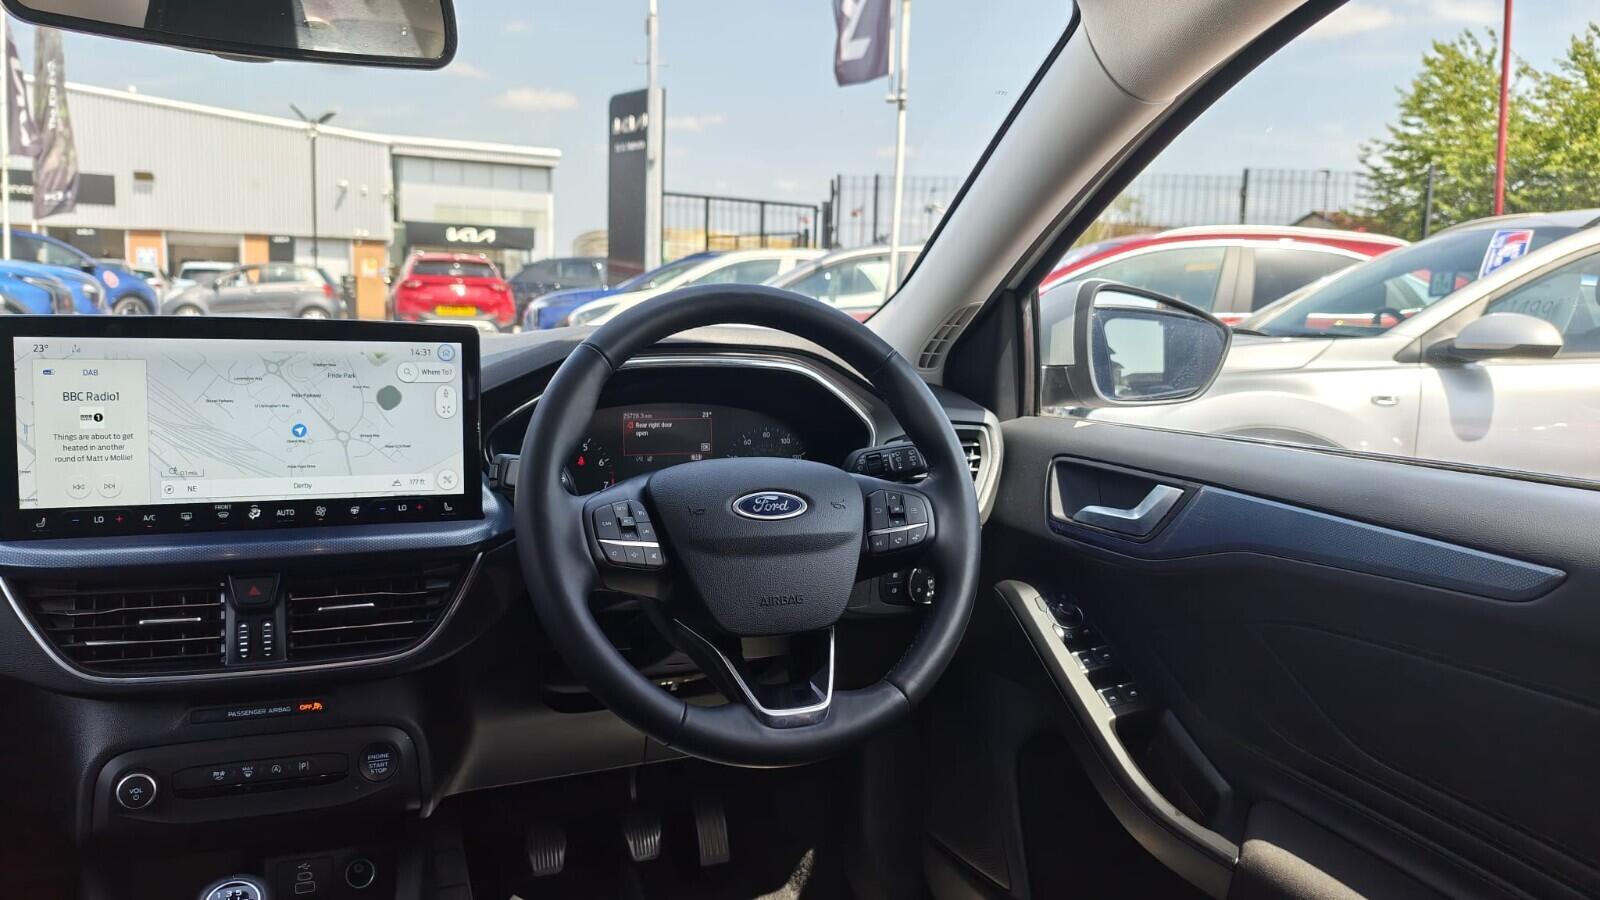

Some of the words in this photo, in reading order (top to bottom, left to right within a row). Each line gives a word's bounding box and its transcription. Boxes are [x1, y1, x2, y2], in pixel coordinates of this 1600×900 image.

[411, 348, 432, 357] 14:31
[82, 369, 99, 377] DAB
[62, 392, 84, 401] BBC
[86, 391, 120, 401] Radio1
[54, 433, 77, 441] Things
[122, 433, 133, 441] get
[62, 443, 88, 451] heated
[55, 454, 75, 462] round
[293, 482, 312, 490] Derby
[409, 478, 419, 486] 177
[752, 494, 790, 513] Ford
[398, 504, 408, 512] LO
[94, 516, 104, 524] LO
[759, 593, 804, 607] AIRBAG
[228, 709, 267, 718] PASSENGER
[268, 706, 291, 714] AIRBAG
[299, 702, 312, 711] OFF
[367, 752, 390, 760] ENGINE
[368, 761, 388, 769] START
